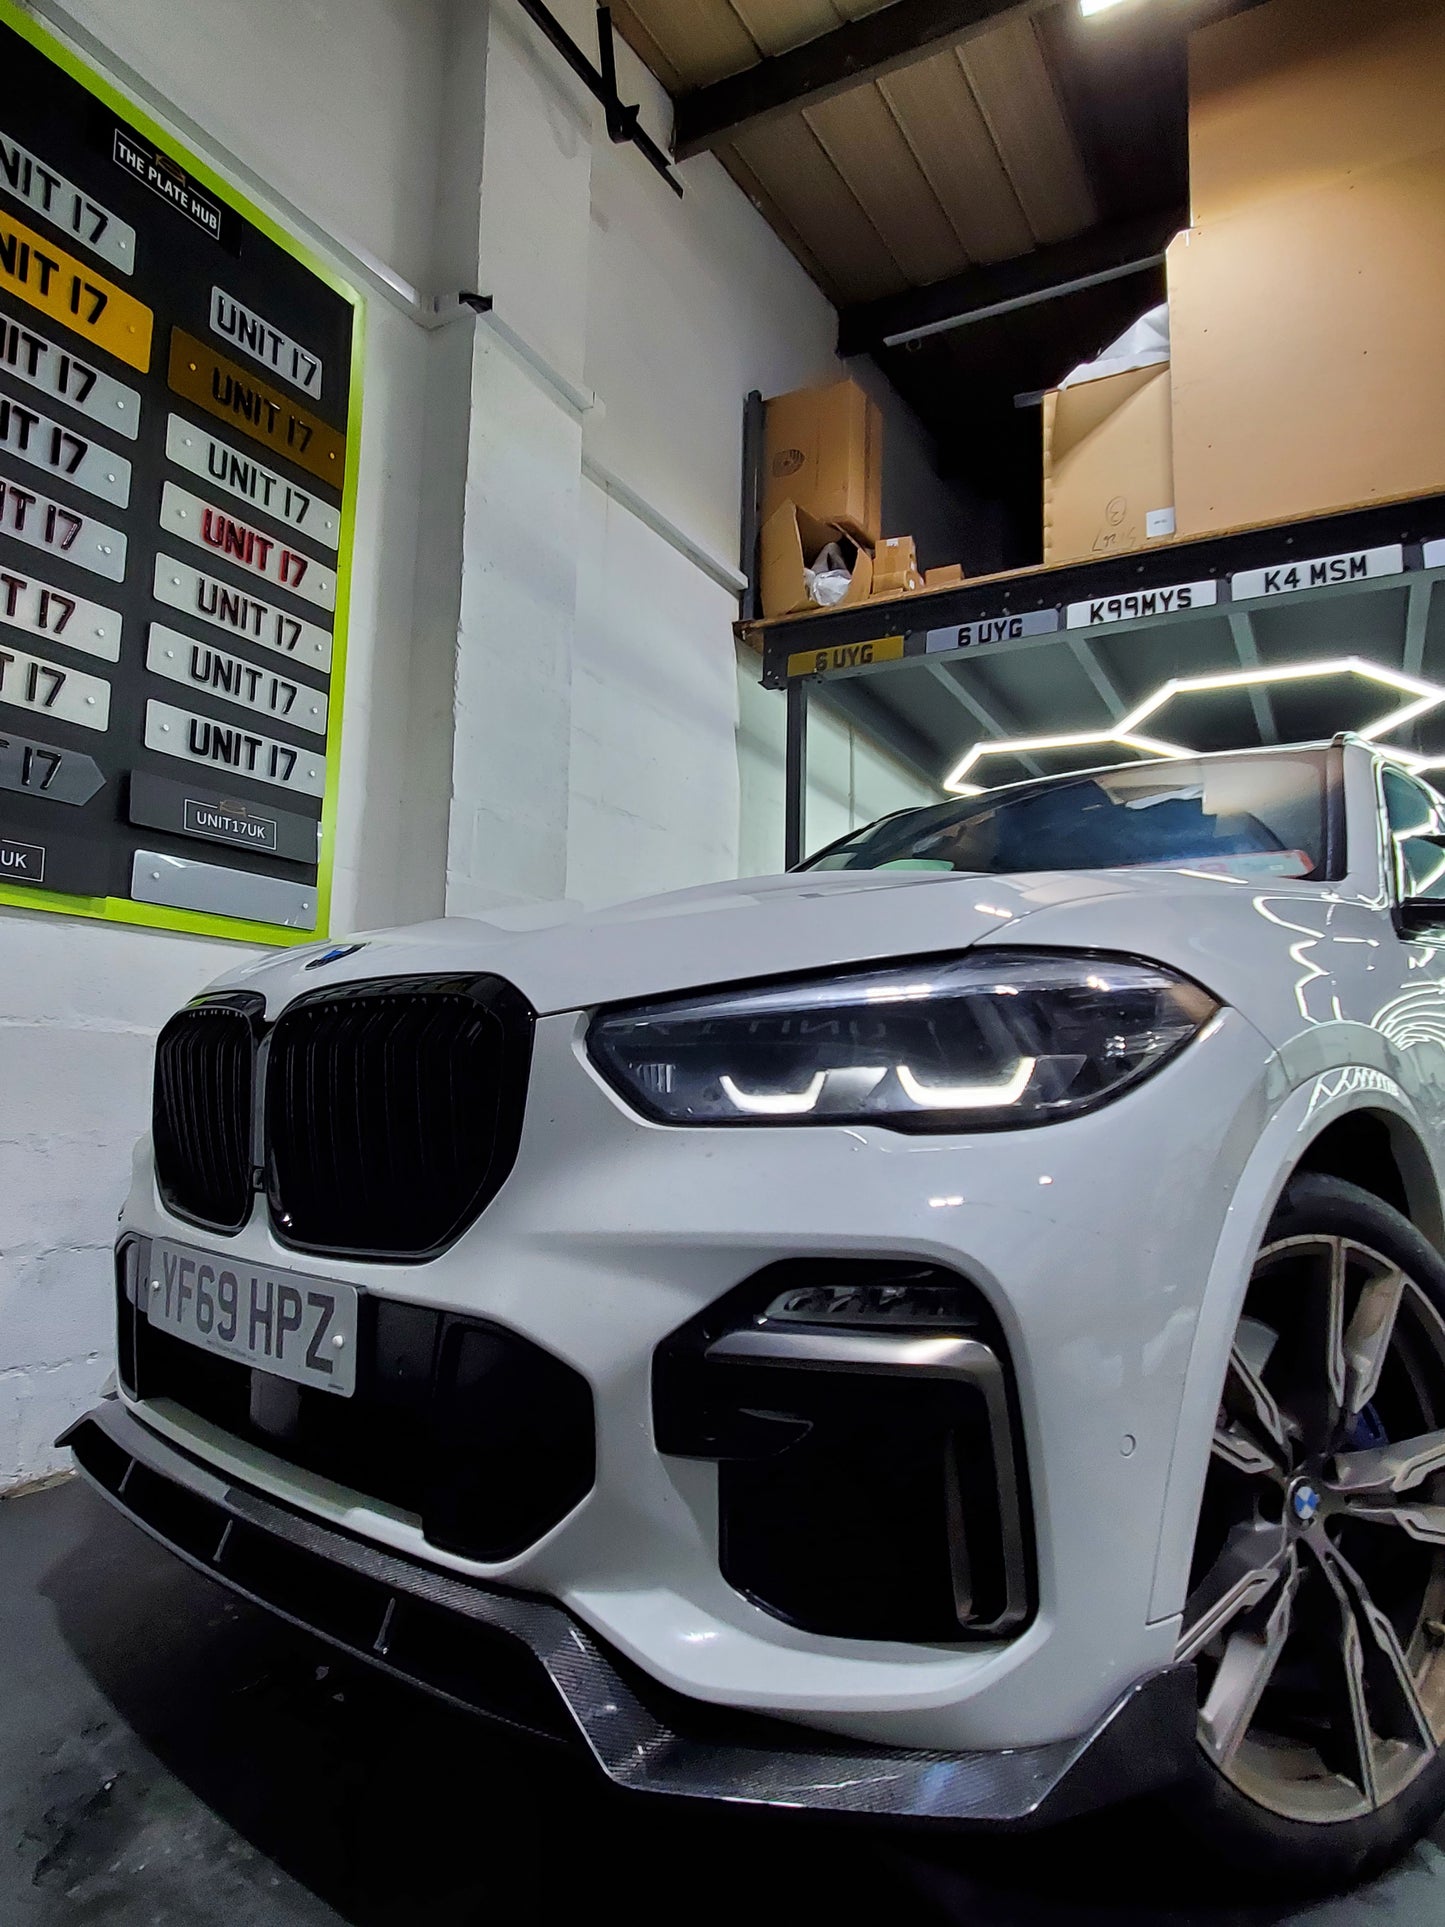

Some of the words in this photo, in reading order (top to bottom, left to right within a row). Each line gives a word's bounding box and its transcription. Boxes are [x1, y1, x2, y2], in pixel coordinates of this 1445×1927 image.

[117, 141, 145, 175] THE
[148, 166, 188, 209] PLATE
[191, 200, 217, 230] HUB
[72, 194, 109, 245] 17
[71, 275, 108, 325] 17
[217, 295, 285, 366] UNIT
[292, 348, 317, 386] 17
[58, 355, 97, 403] 17
[212, 367, 281, 434] UNIT
[287, 415, 313, 452] 17
[51, 427, 88, 474] 17
[208, 442, 277, 506] UNIT
[285, 486, 311, 524] 17
[45, 504, 83, 550] 17
[202, 508, 274, 571] UNIT
[279, 550, 308, 588] 17
[1264, 569, 1300, 593] K4
[1310, 555, 1367, 585] MSM
[38, 589, 76, 634] 17
[198, 577, 268, 636] UNIT
[276, 614, 303, 651] 17
[1090, 588, 1192, 623] K99MYS
[957, 627, 971, 647] 6
[978, 618, 1023, 643] UYG
[191, 645, 263, 702] UNIT
[271, 678, 298, 715] 17
[815, 651, 827, 671] 6
[833, 644, 873, 668] UYG
[27, 663, 66, 707] 17
[22, 746, 62, 790] 17
[190, 718, 263, 771] UNIT
[270, 744, 297, 780] 17
[196, 810, 266, 839] UNIT17UK
[163, 1251, 238, 1342] YF69
[249, 1278, 335, 1375] HPZ
